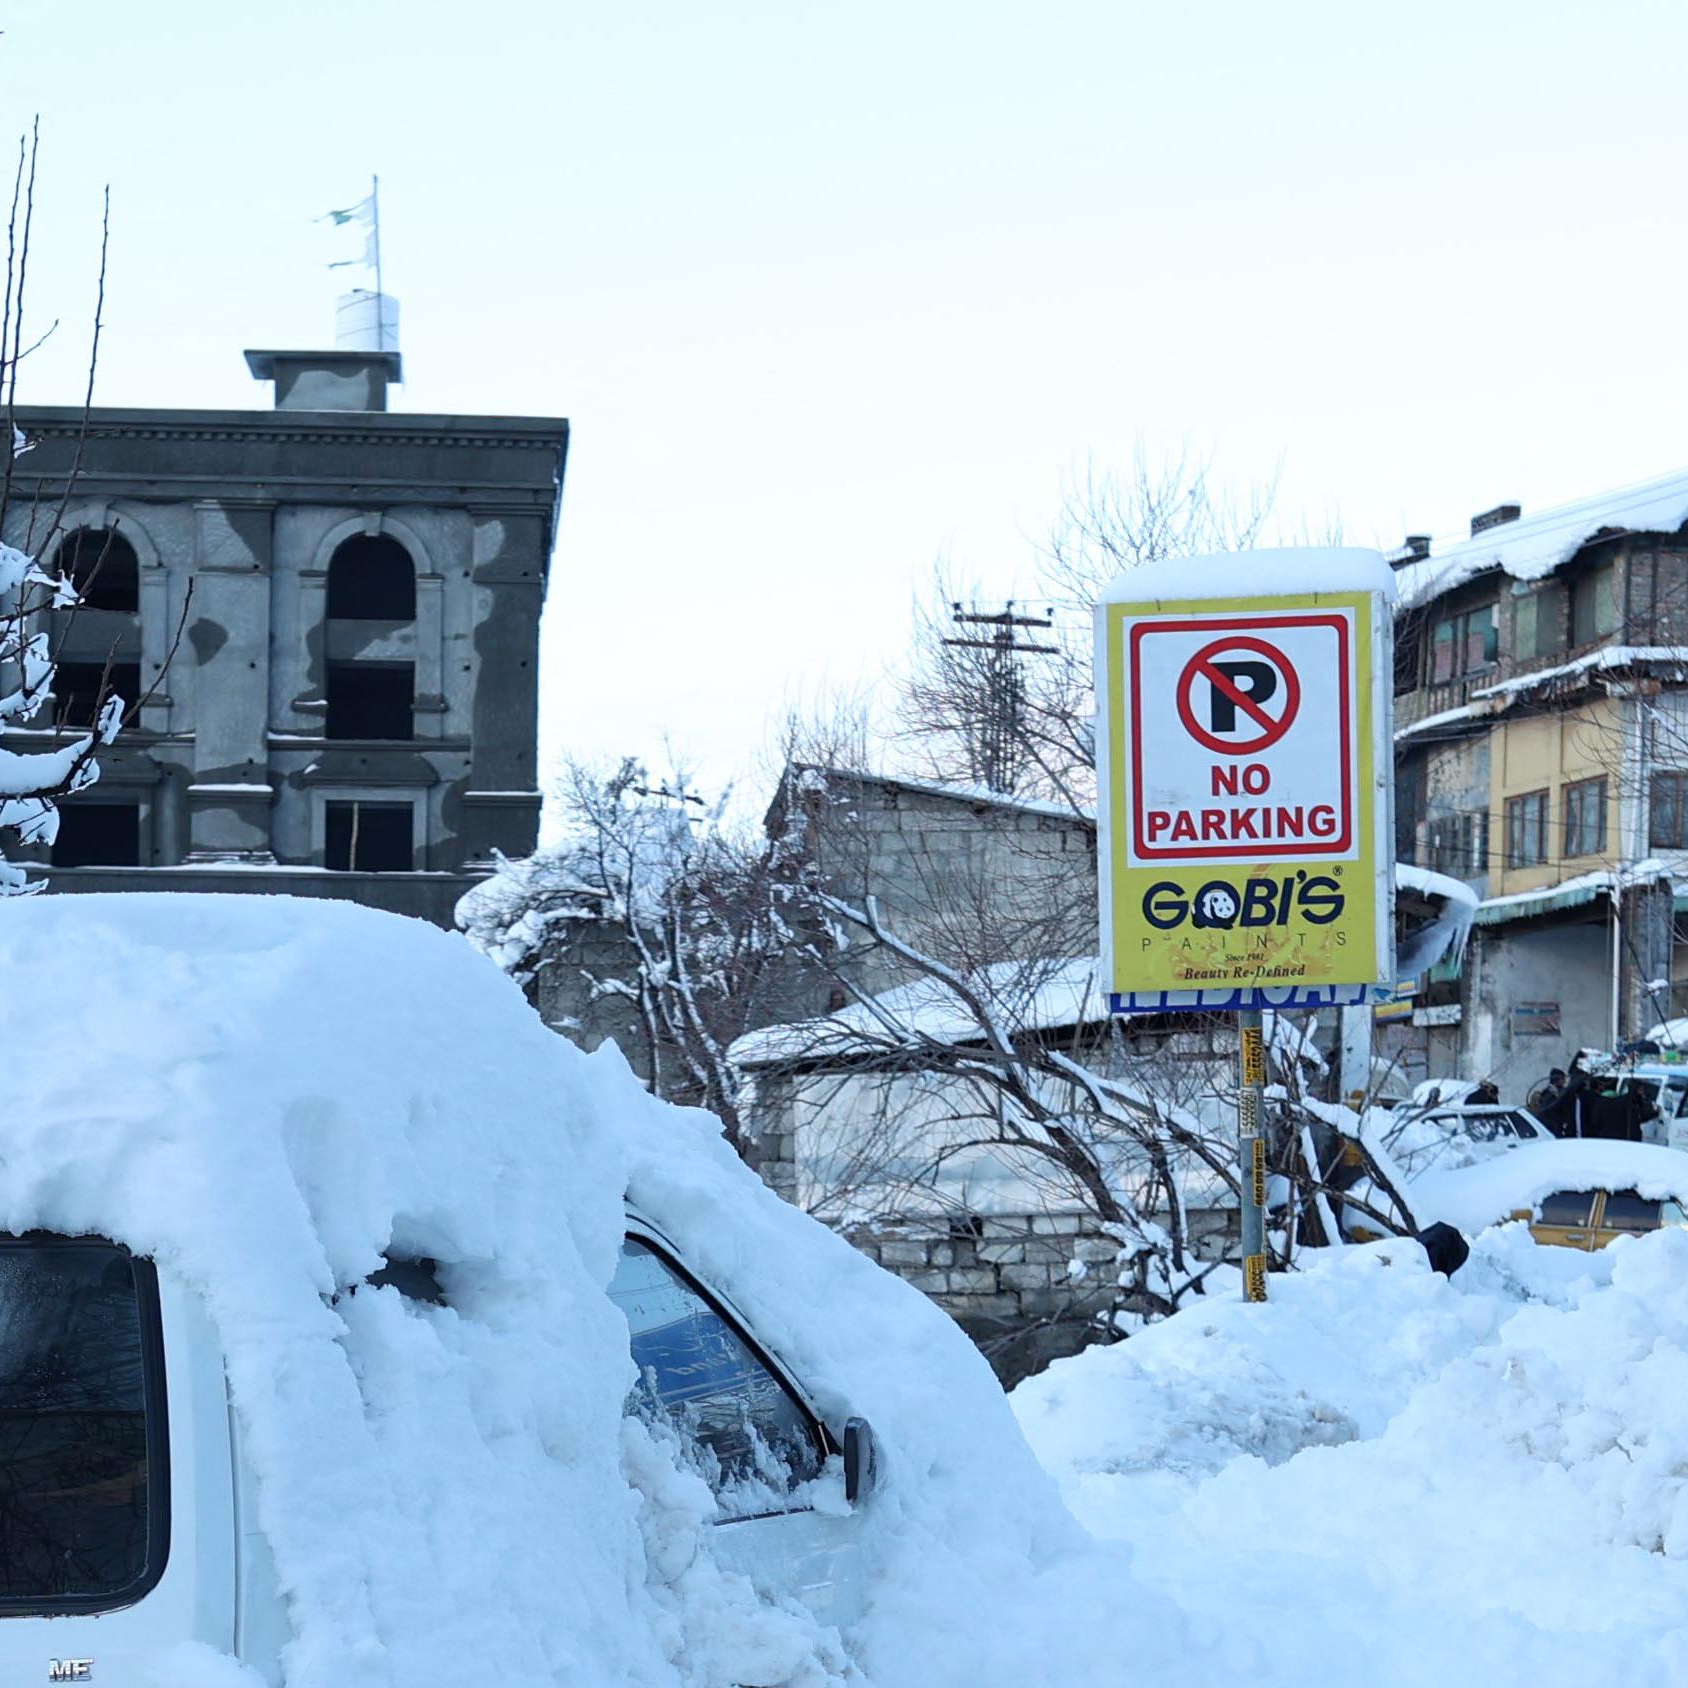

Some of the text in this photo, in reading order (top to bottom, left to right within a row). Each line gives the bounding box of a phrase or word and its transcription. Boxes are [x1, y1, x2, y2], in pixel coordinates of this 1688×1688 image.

[1211, 763, 1272, 796] NO
[1147, 805, 1336, 843] PARKING
[1142, 869, 1345, 930] GOBI'S
[1184, 963, 1306, 980] Beauty Re-Defined
